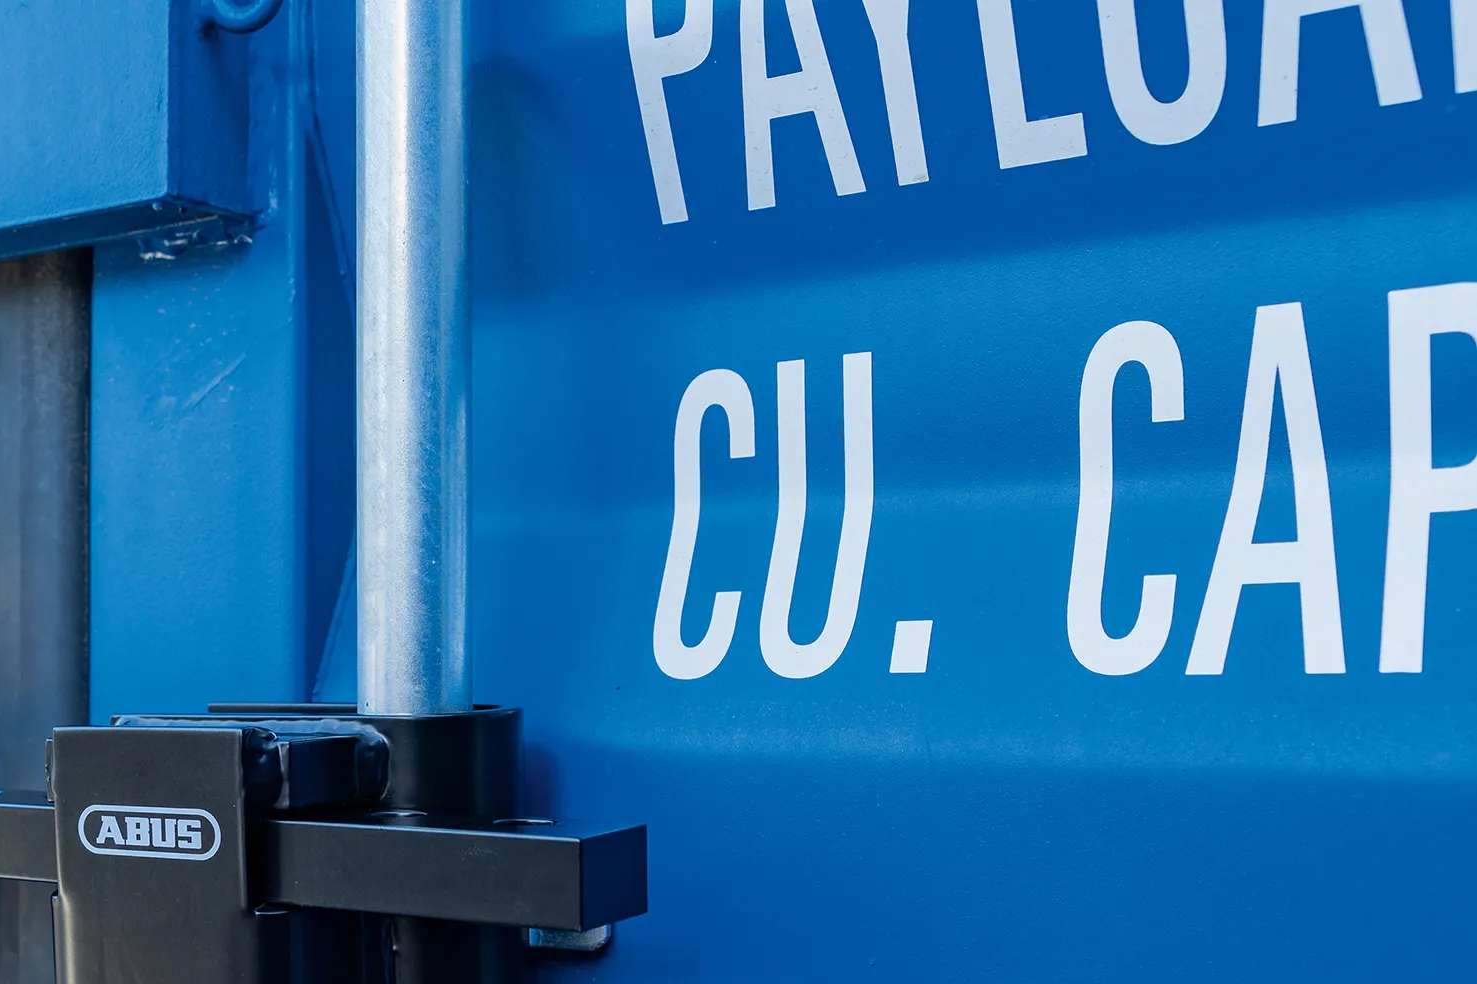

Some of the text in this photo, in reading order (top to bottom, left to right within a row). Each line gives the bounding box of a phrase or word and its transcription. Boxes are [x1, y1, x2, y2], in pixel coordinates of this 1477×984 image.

[626, 0, 1477, 225] PAYL
[653, 352, 933, 680] CU.
[96, 815, 202, 850] ABUS
